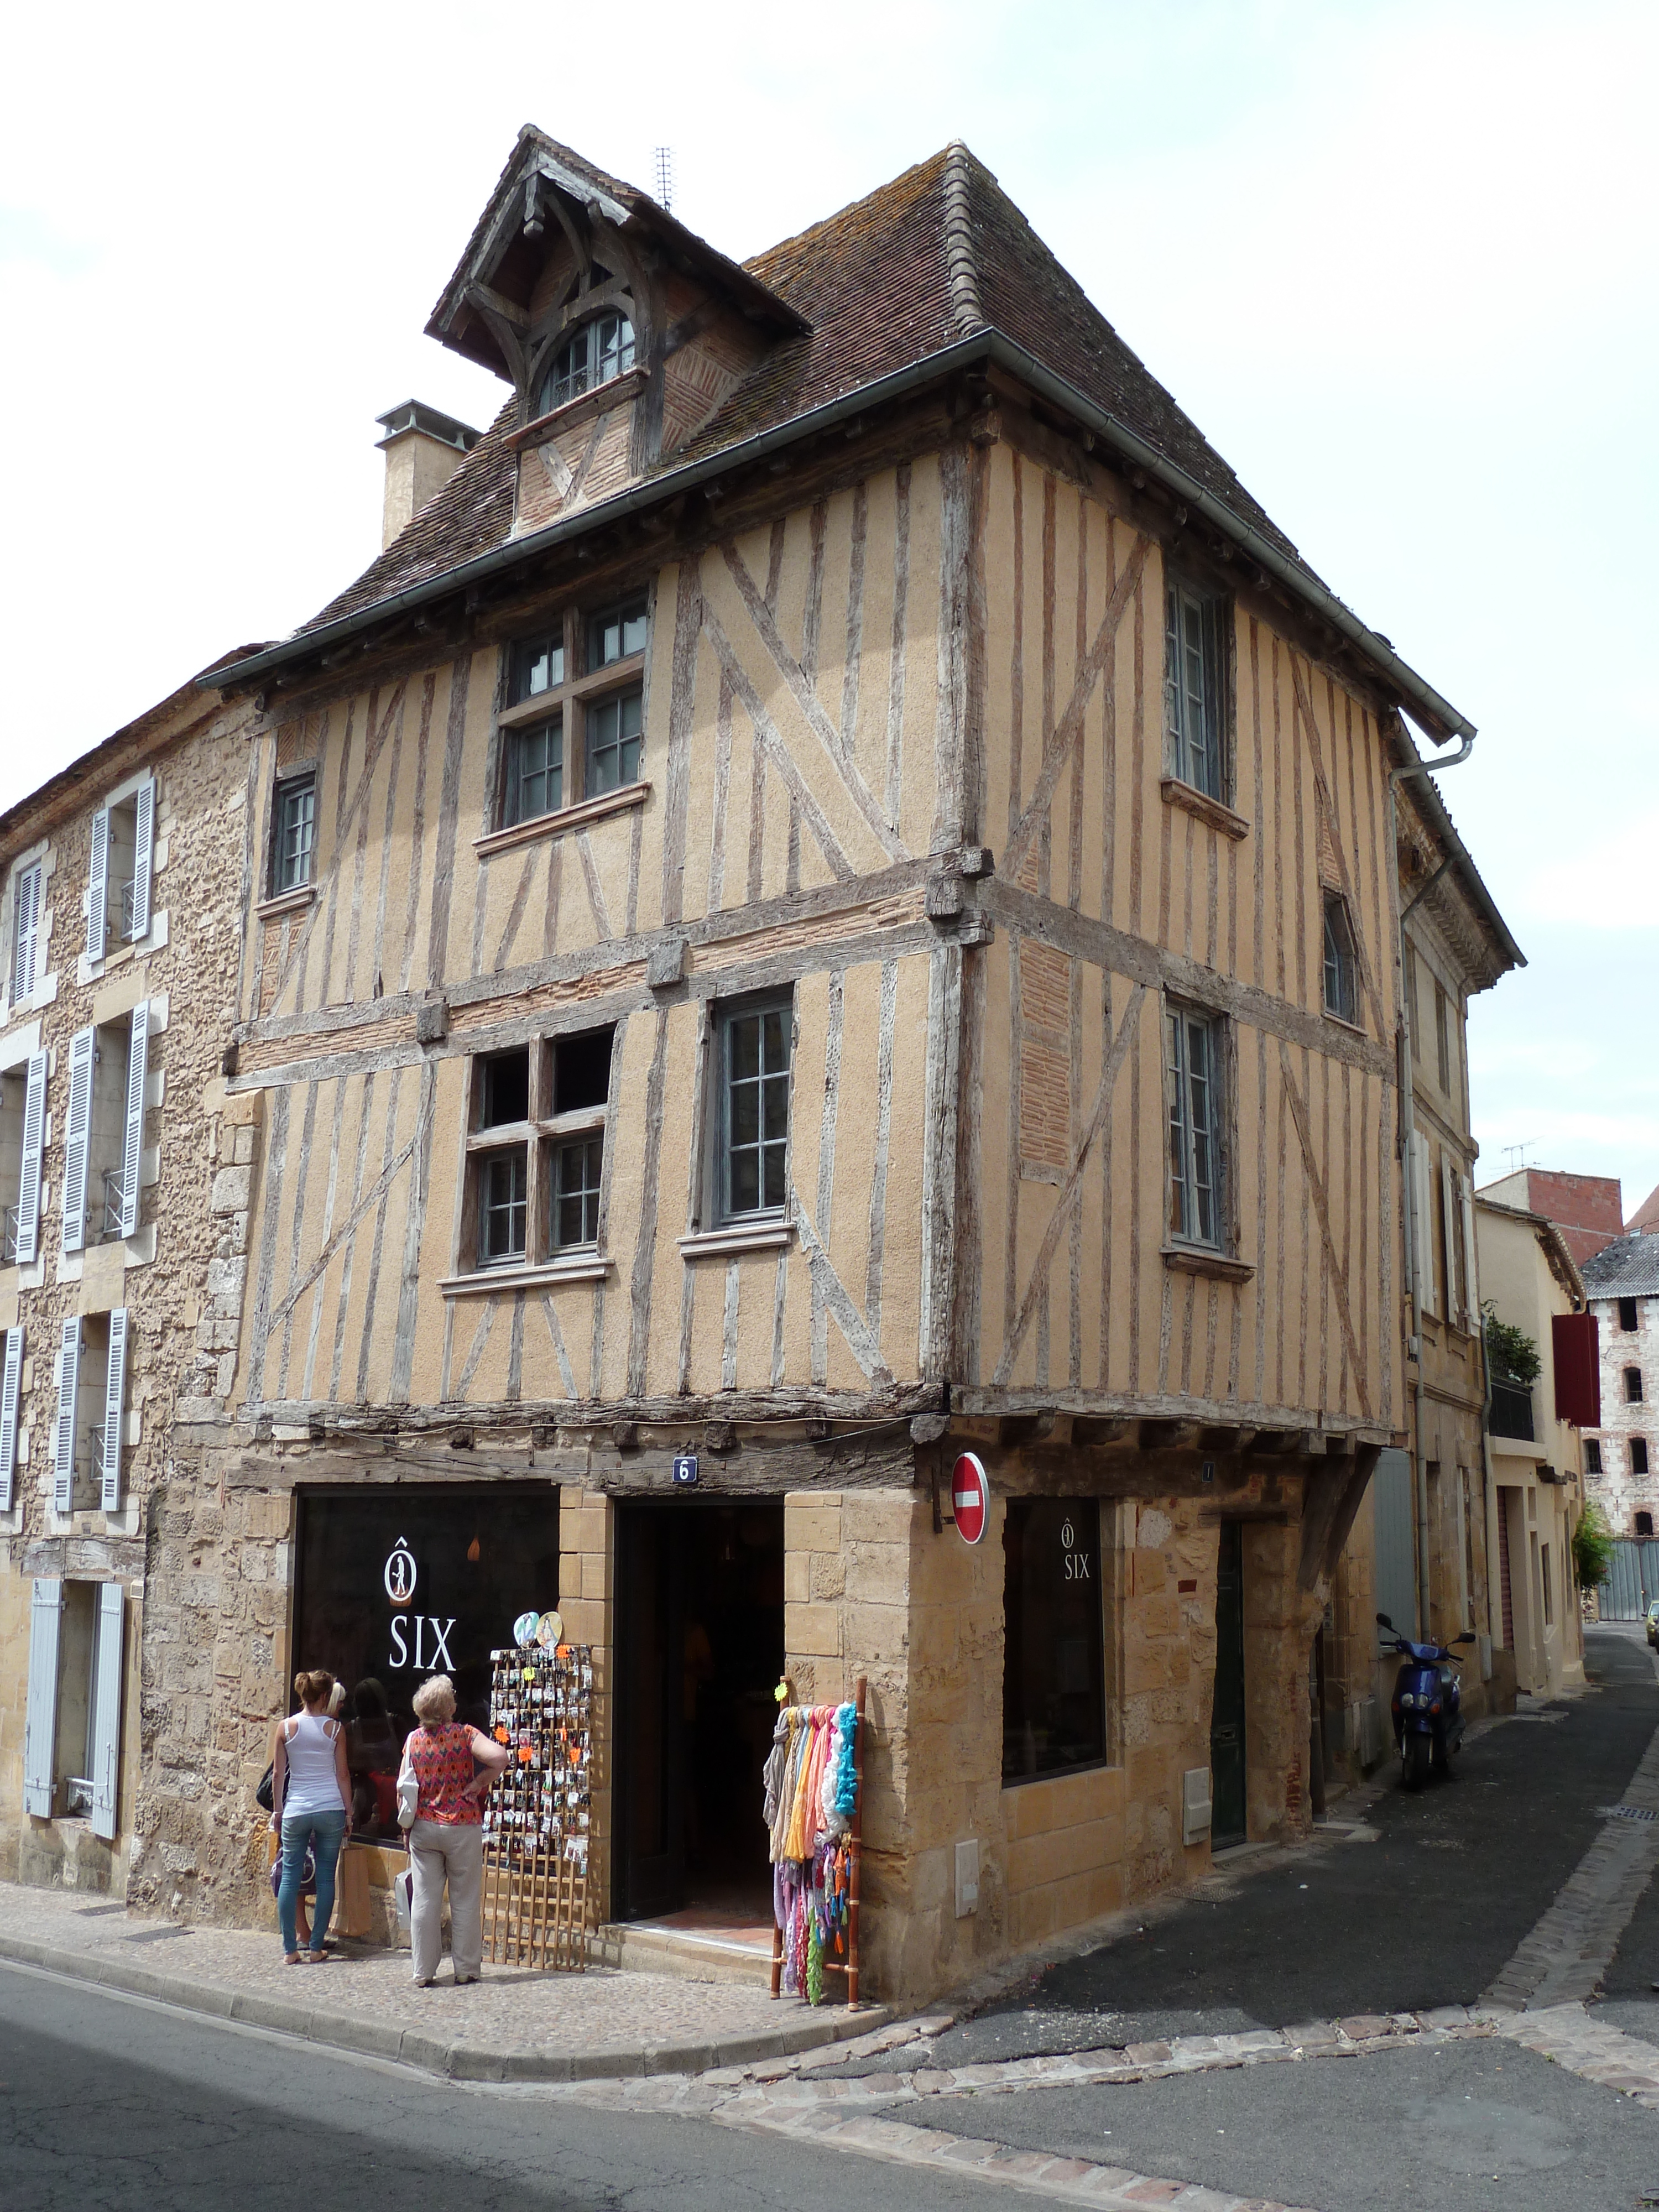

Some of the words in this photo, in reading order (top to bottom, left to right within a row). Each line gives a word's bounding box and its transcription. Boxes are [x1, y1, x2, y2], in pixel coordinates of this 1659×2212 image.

[680, 1459, 689, 1480] 6
[1065, 1553, 1090, 1580] SIX
[389, 1615, 457, 1671] SIX
